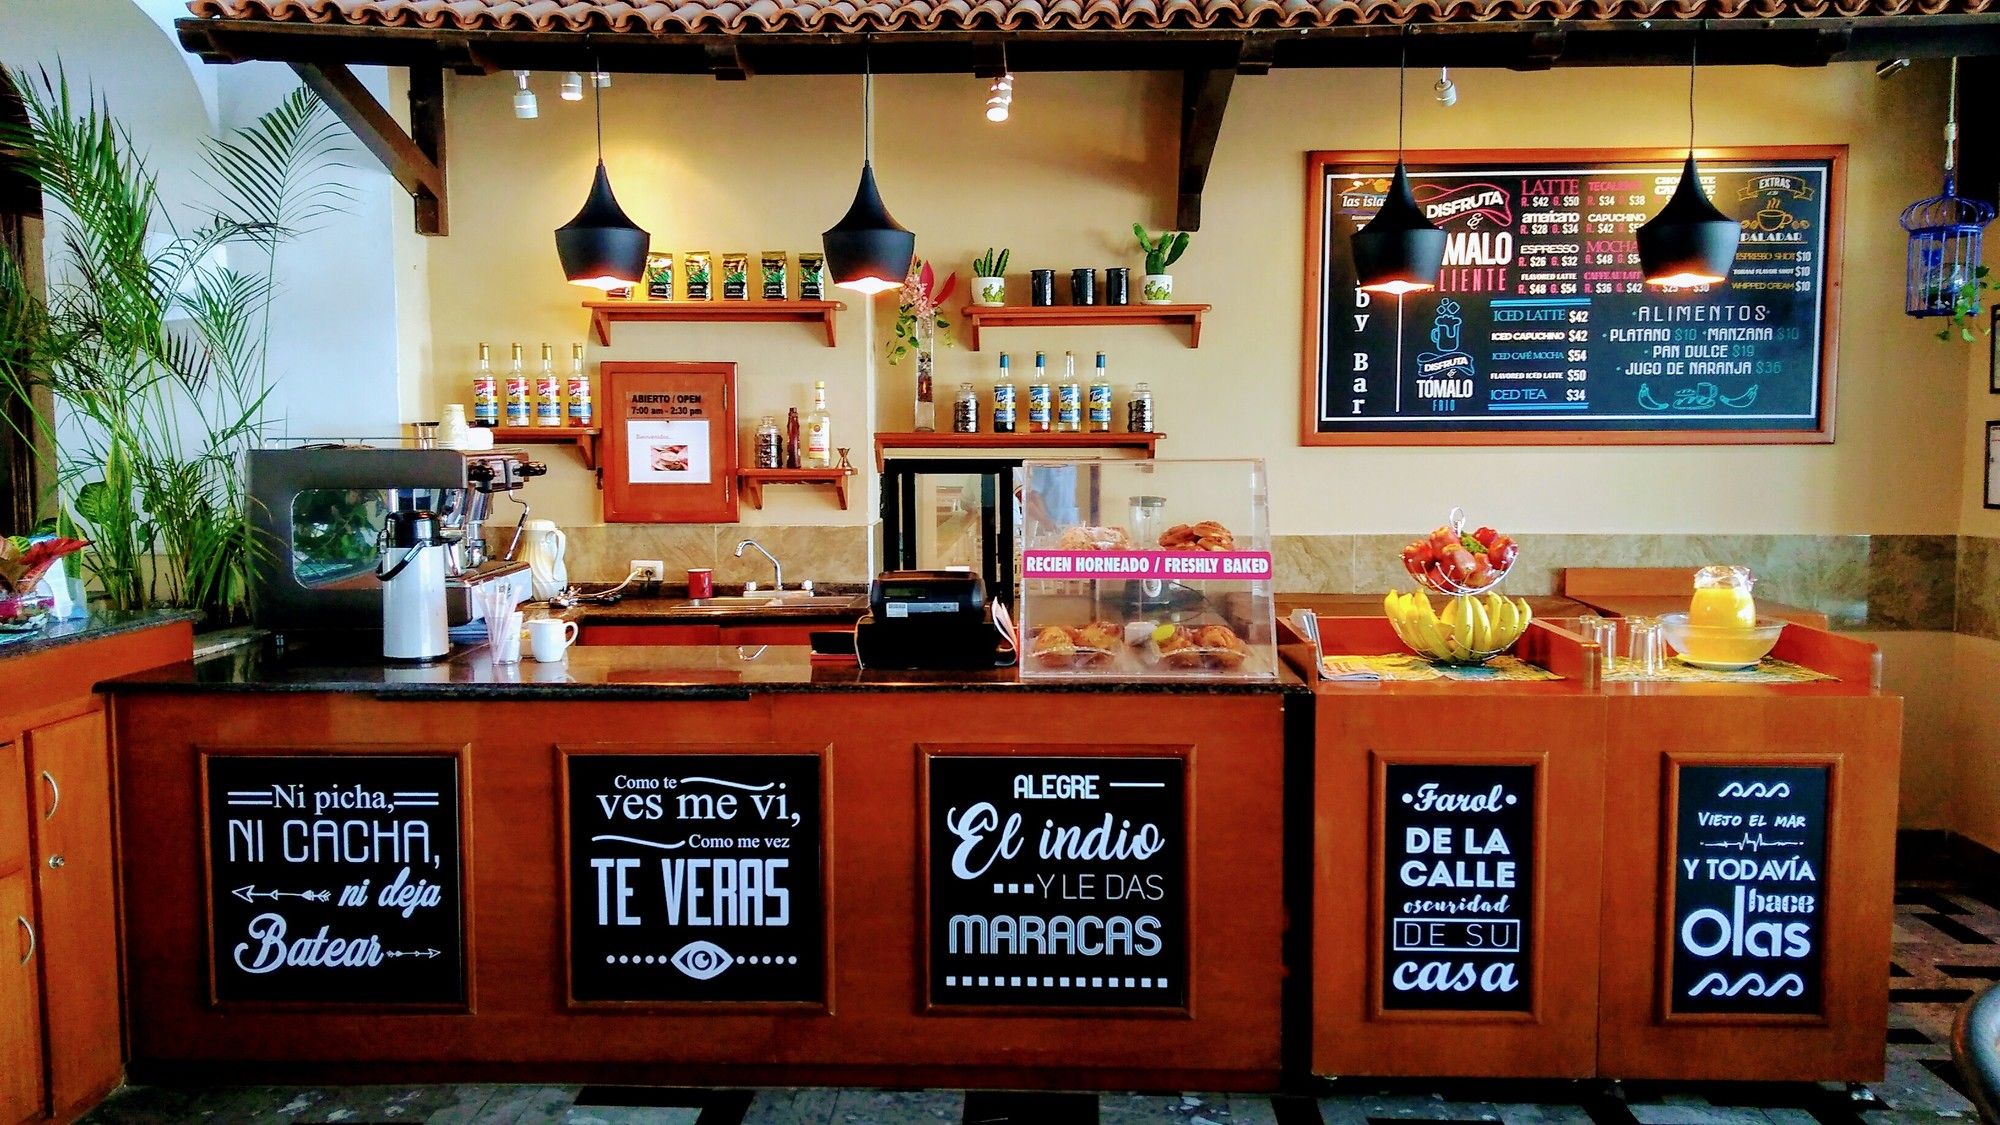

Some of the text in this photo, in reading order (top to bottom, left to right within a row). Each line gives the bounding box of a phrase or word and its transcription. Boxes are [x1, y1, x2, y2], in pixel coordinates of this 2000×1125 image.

[1521, 179, 1579, 196] LATTE
[1758, 177, 1791, 190] EXTRAS
[1342, 195, 1360, 208] las
[1426, 190, 1504, 219] DISFRUTA
[1532, 196, 1549, 207] $42
[1563, 196, 1580, 207] $50
[1598, 195, 1615, 207] $34
[1628, 195, 1646, 206] $38
[1466, 212, 1484, 230] &
[1521, 210, 1580, 223] americano
[1587, 213, 1646, 222] CAPUCHINO
[1531, 224, 1548, 235] $28
[1562, 224, 1579, 235] $34
[1597, 223, 1614, 234] $42
[1440, 231, 1513, 266] MALO
[1520, 244, 1580, 254] ESPRESSO
[1586, 240, 1639, 253] MOCHA
[1529, 257, 1547, 267] $26
[1561, 256, 1578, 267] $32
[1596, 254, 1613, 265] $48
[1796, 251, 1812, 262] $10
[1520, 273, 1556, 281] FLAVORED
[1795, 266, 1811, 277] $10
[1439, 268, 1507, 292] LIENTE
[1795, 280, 1811, 292] $10
[1529, 284, 1546, 295] $48
[1560, 283, 1577, 294] $54
[1595, 283, 1612, 294] $36
[1626, 282, 1643, 294] $42
[1493, 309, 1589, 324] ICED LATTE $42
[1638, 305, 1767, 322] ALIMENTOS
[1491, 330, 1589, 343] ICED CAPUCHINO $42
[1609, 327, 1800, 342] PLATANO $10 MANZANA $10
[1492, 349, 1588, 362] ICED CAFÉ MOCHA $54
[1653, 344, 1755, 359] PAN DULCE $19
[1424, 356, 1469, 373] DISFRUTA
[1625, 361, 1782, 376] JUGO DE NARANJA $36
[1490, 369, 1587, 382] FLAVORED ICED LATTE $50
[1352, 353, 1369, 414] Bar
[1416, 376, 1474, 398] TÓMALO
[631, 394, 670, 404] ABIERTO
[677, 395, 702, 404] OPEN
[1490, 389, 1586, 402] ICED TEA $34
[631, 406, 649, 415] 7:00
[670, 406, 688, 415] 2:30
[689, 408, 703, 417] pm
[1433, 399, 1456, 412] FRIO
[1026, 556, 1269, 574] RECIEN HORNEADO / FRESHLY BAKED
[614, 774, 677, 790] Como te
[1013, 774, 1100, 800] ALEGRE
[272, 784, 395, 815] Ni picha,
[596, 782, 801, 828] ves me vi,
[1413, 782, 1504, 813] Farol
[1698, 811, 1807, 829] VIEJO EL MAR
[228, 819, 440, 869] NI CACHA,
[688, 834, 790, 849] Como me vez
[946, 801, 1166, 880] El indio
[1405, 827, 1511, 855] DE LA
[1400, 860, 1516, 889] CALLE
[1682, 855, 1816, 882] Y TODAVÍA
[337, 866, 442, 919] ni deja
[590, 858, 790, 926] TE VERAS
[1036, 873, 1165, 901] Y LE DAS
[1403, 894, 1511, 915] oscuridad
[1748, 888, 1815, 914] hace
[949, 914, 1163, 957] MARACAS
[1404, 923, 1510, 947] DE SU
[233, 912, 386, 974] Batear
[1392, 961, 1519, 992] casa
